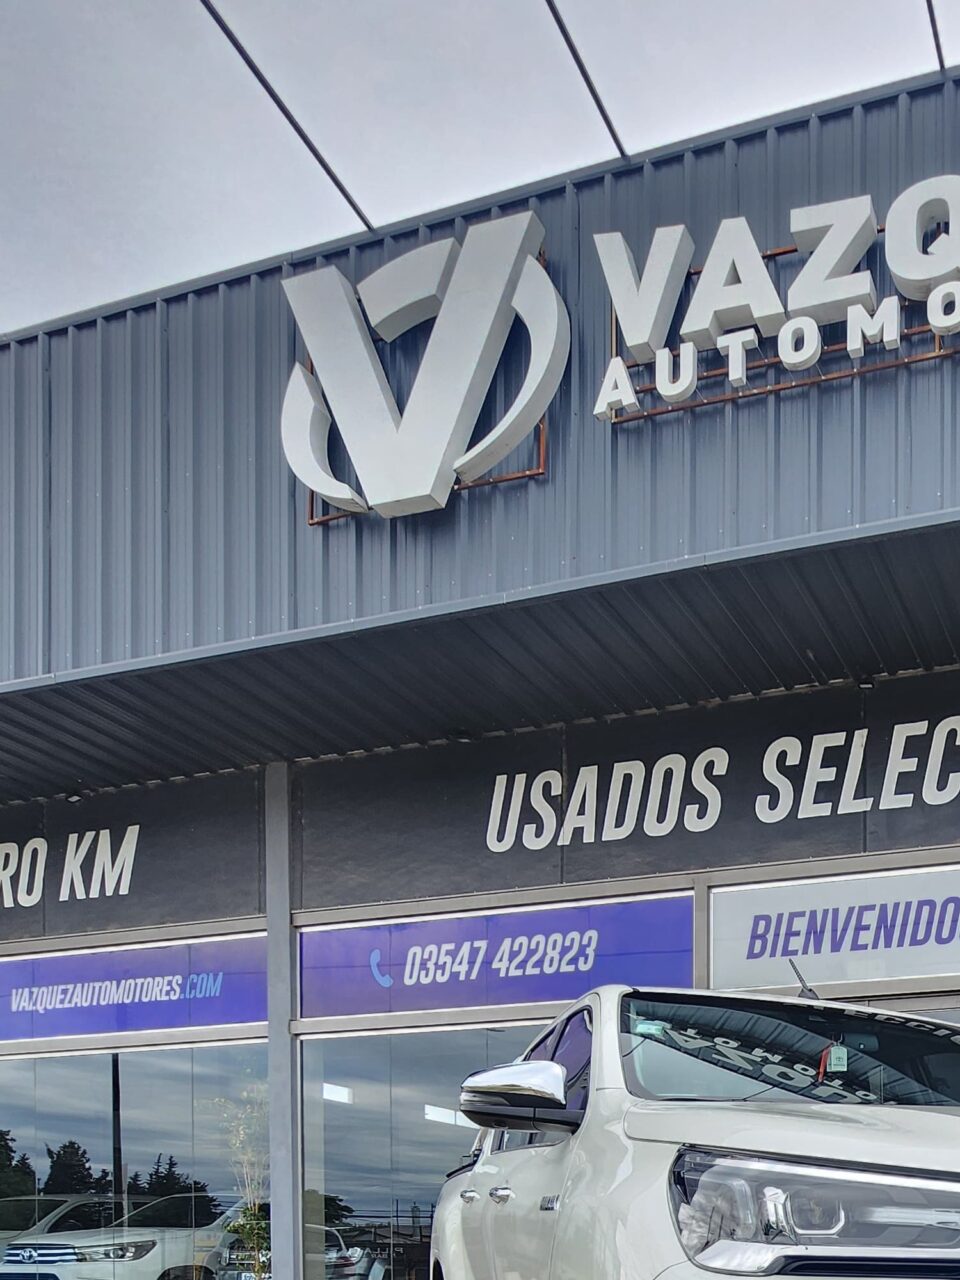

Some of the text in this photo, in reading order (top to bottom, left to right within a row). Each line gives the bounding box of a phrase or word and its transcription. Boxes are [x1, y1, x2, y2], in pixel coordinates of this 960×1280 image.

[485, 746, 730, 854] USADOS
[58, 823, 141, 902] KM
[403, 929, 599, 987] 03547 422823
[11, 971, 224, 1014] VAZQUEZAUTOMOTORES.COM
